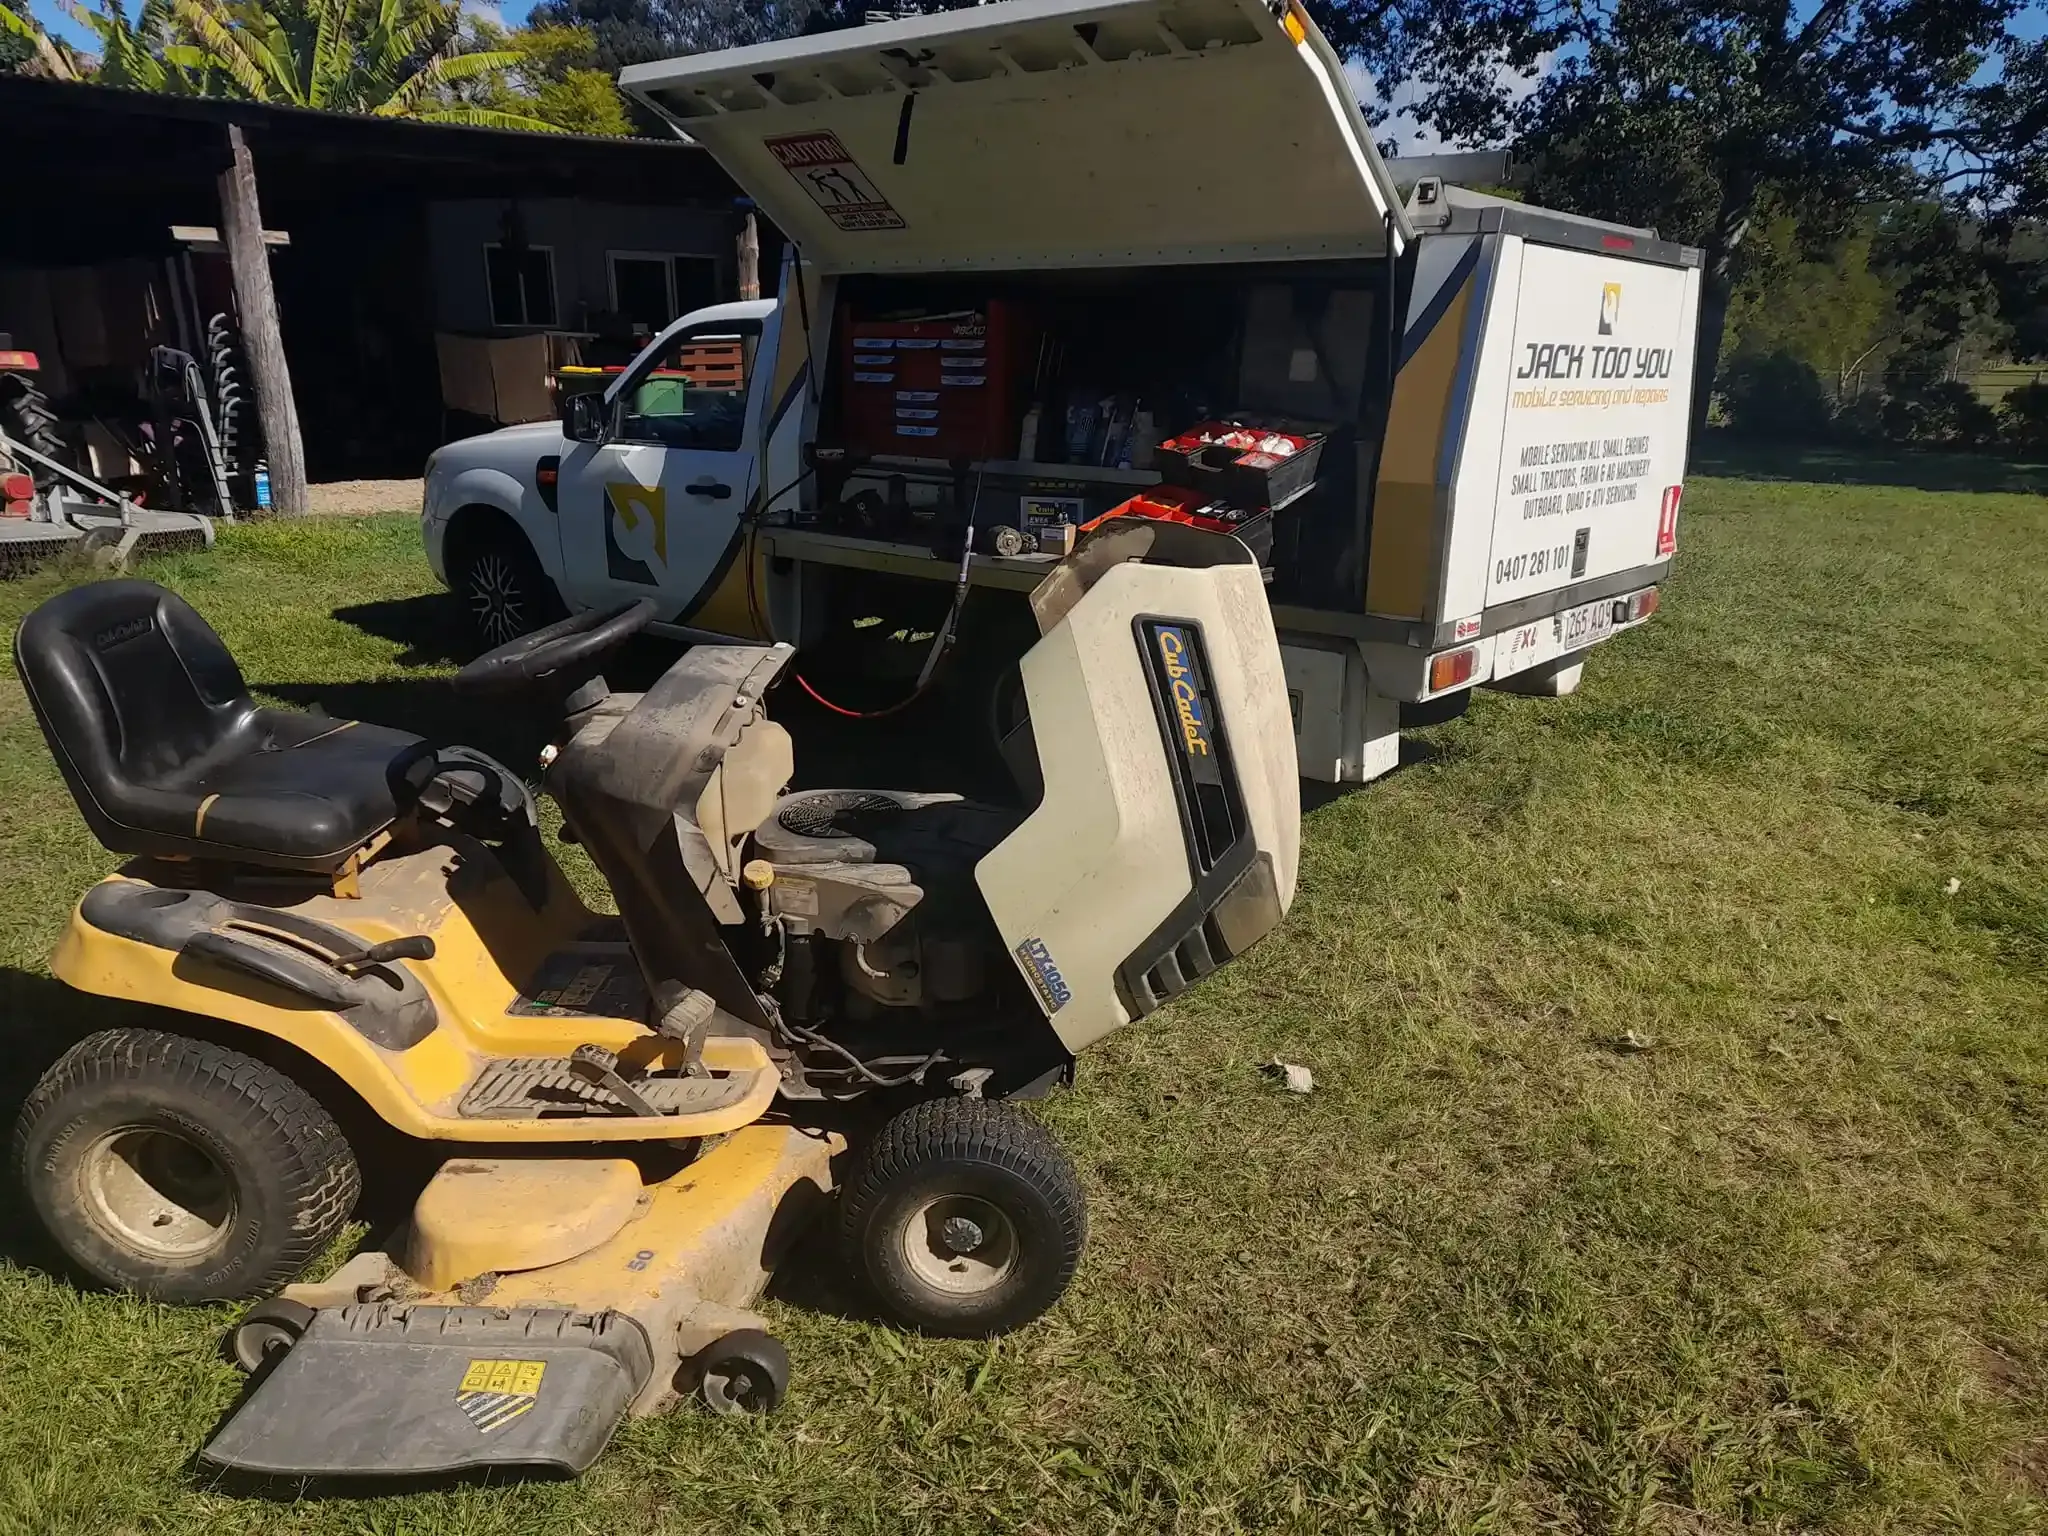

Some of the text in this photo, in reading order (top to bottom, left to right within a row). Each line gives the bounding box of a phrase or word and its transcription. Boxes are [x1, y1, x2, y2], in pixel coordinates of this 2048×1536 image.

[771, 138, 846, 165] CAUTION
[1517, 343, 1673, 379] JACK TOO YOU
[1512, 385, 1669, 409] mobile servicing and repairs
[1520, 436, 1650, 467] MOBILE SERVICING ALL SMALL ENGINES
[1511, 459, 1651, 496] SMALL TRACTORS, FARM & AG MACHINERY
[1523, 483, 1637, 520] OUTBOARD, QUAD & ATV SERVICING
[1496, 544, 1570, 584] 0407 281 101
[1521, 627, 1537, 649] XL
[1568, 608, 1588, 639] 265
[1159, 631, 1208, 756] Cub Cadet
[1028, 938, 1072, 1003] LTX1050
[45, 1114, 88, 1172] CARLISLE
